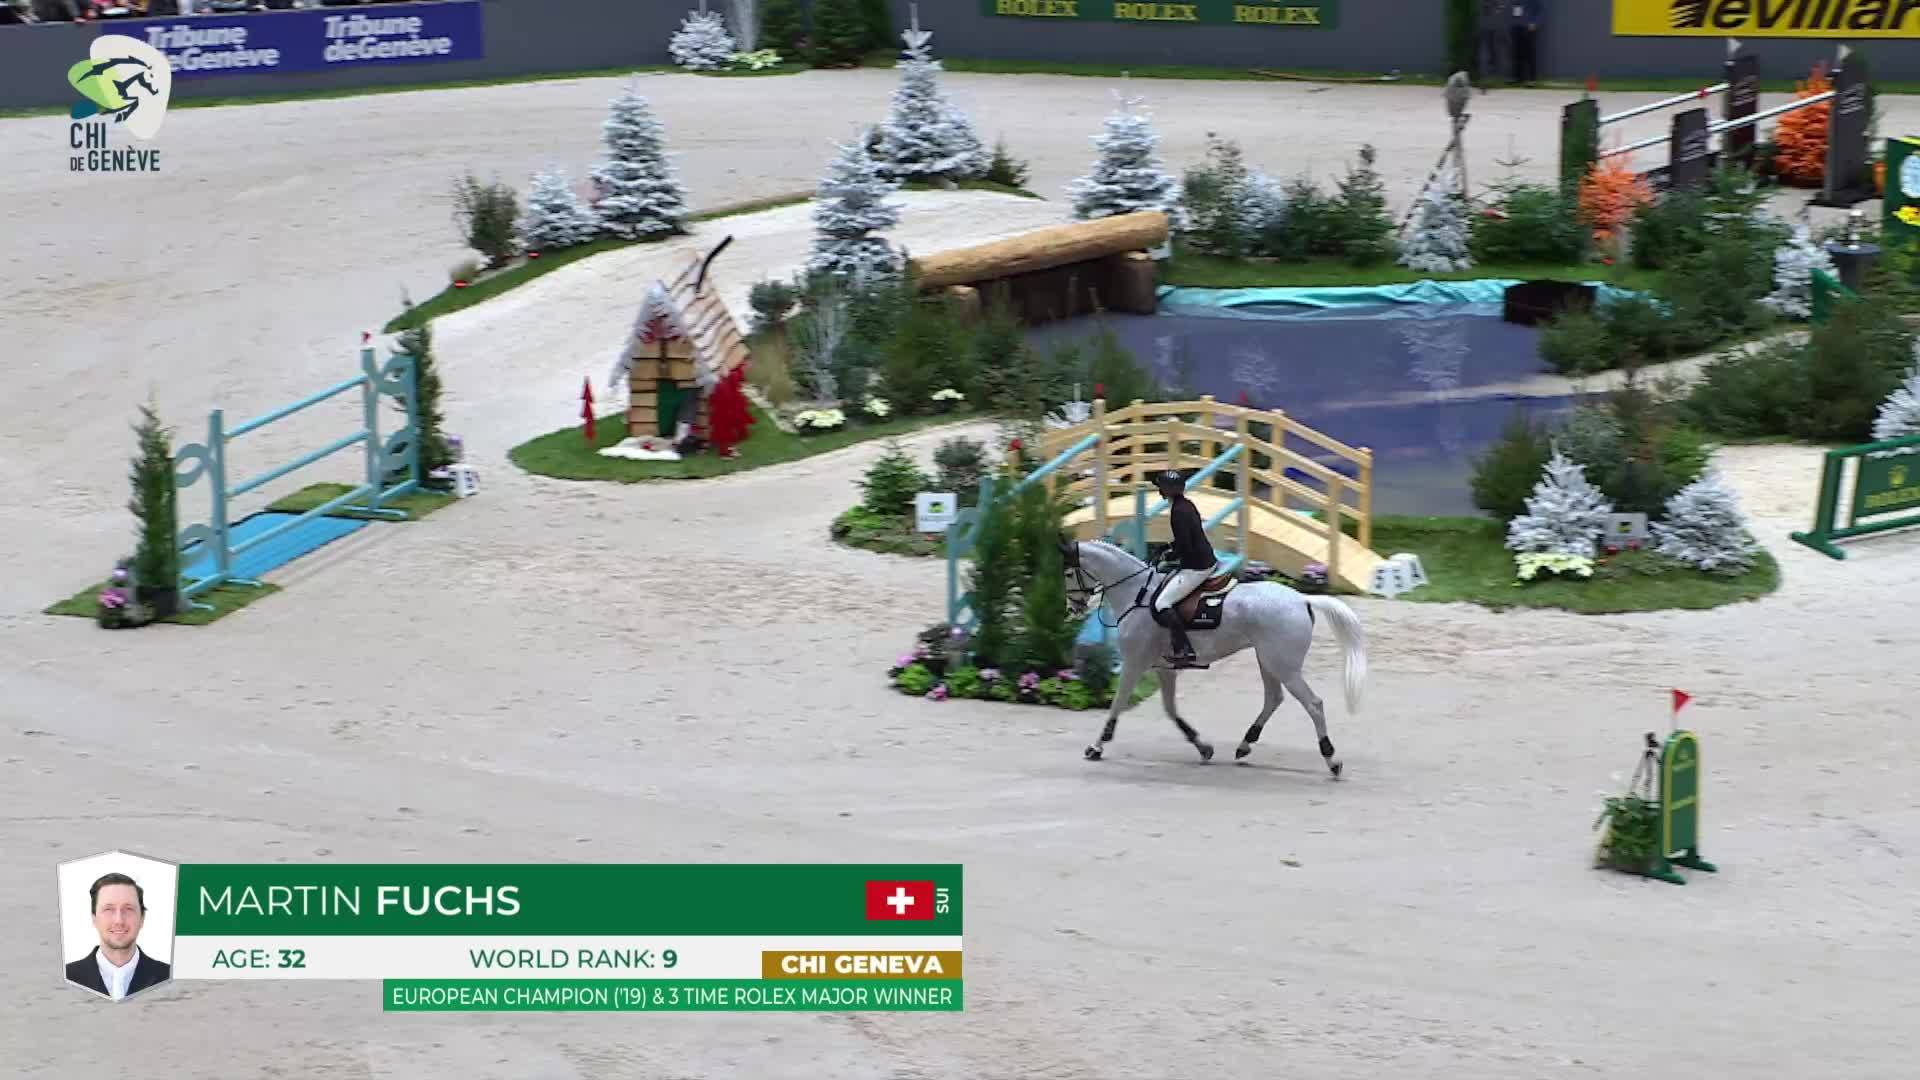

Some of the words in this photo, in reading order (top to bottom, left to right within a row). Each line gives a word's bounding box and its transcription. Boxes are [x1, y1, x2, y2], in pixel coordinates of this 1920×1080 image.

[994, 0, 1079, 16] ROLEX
[1113, 2, 1198, 20] ROLEX
[1232, 5, 1321, 24] ROLEX
[144, 25, 247, 48] Tribune
[323, 15, 423, 38] Tribune
[163, 45, 280, 71] eGenève
[323, 34, 453, 62] deGenève
